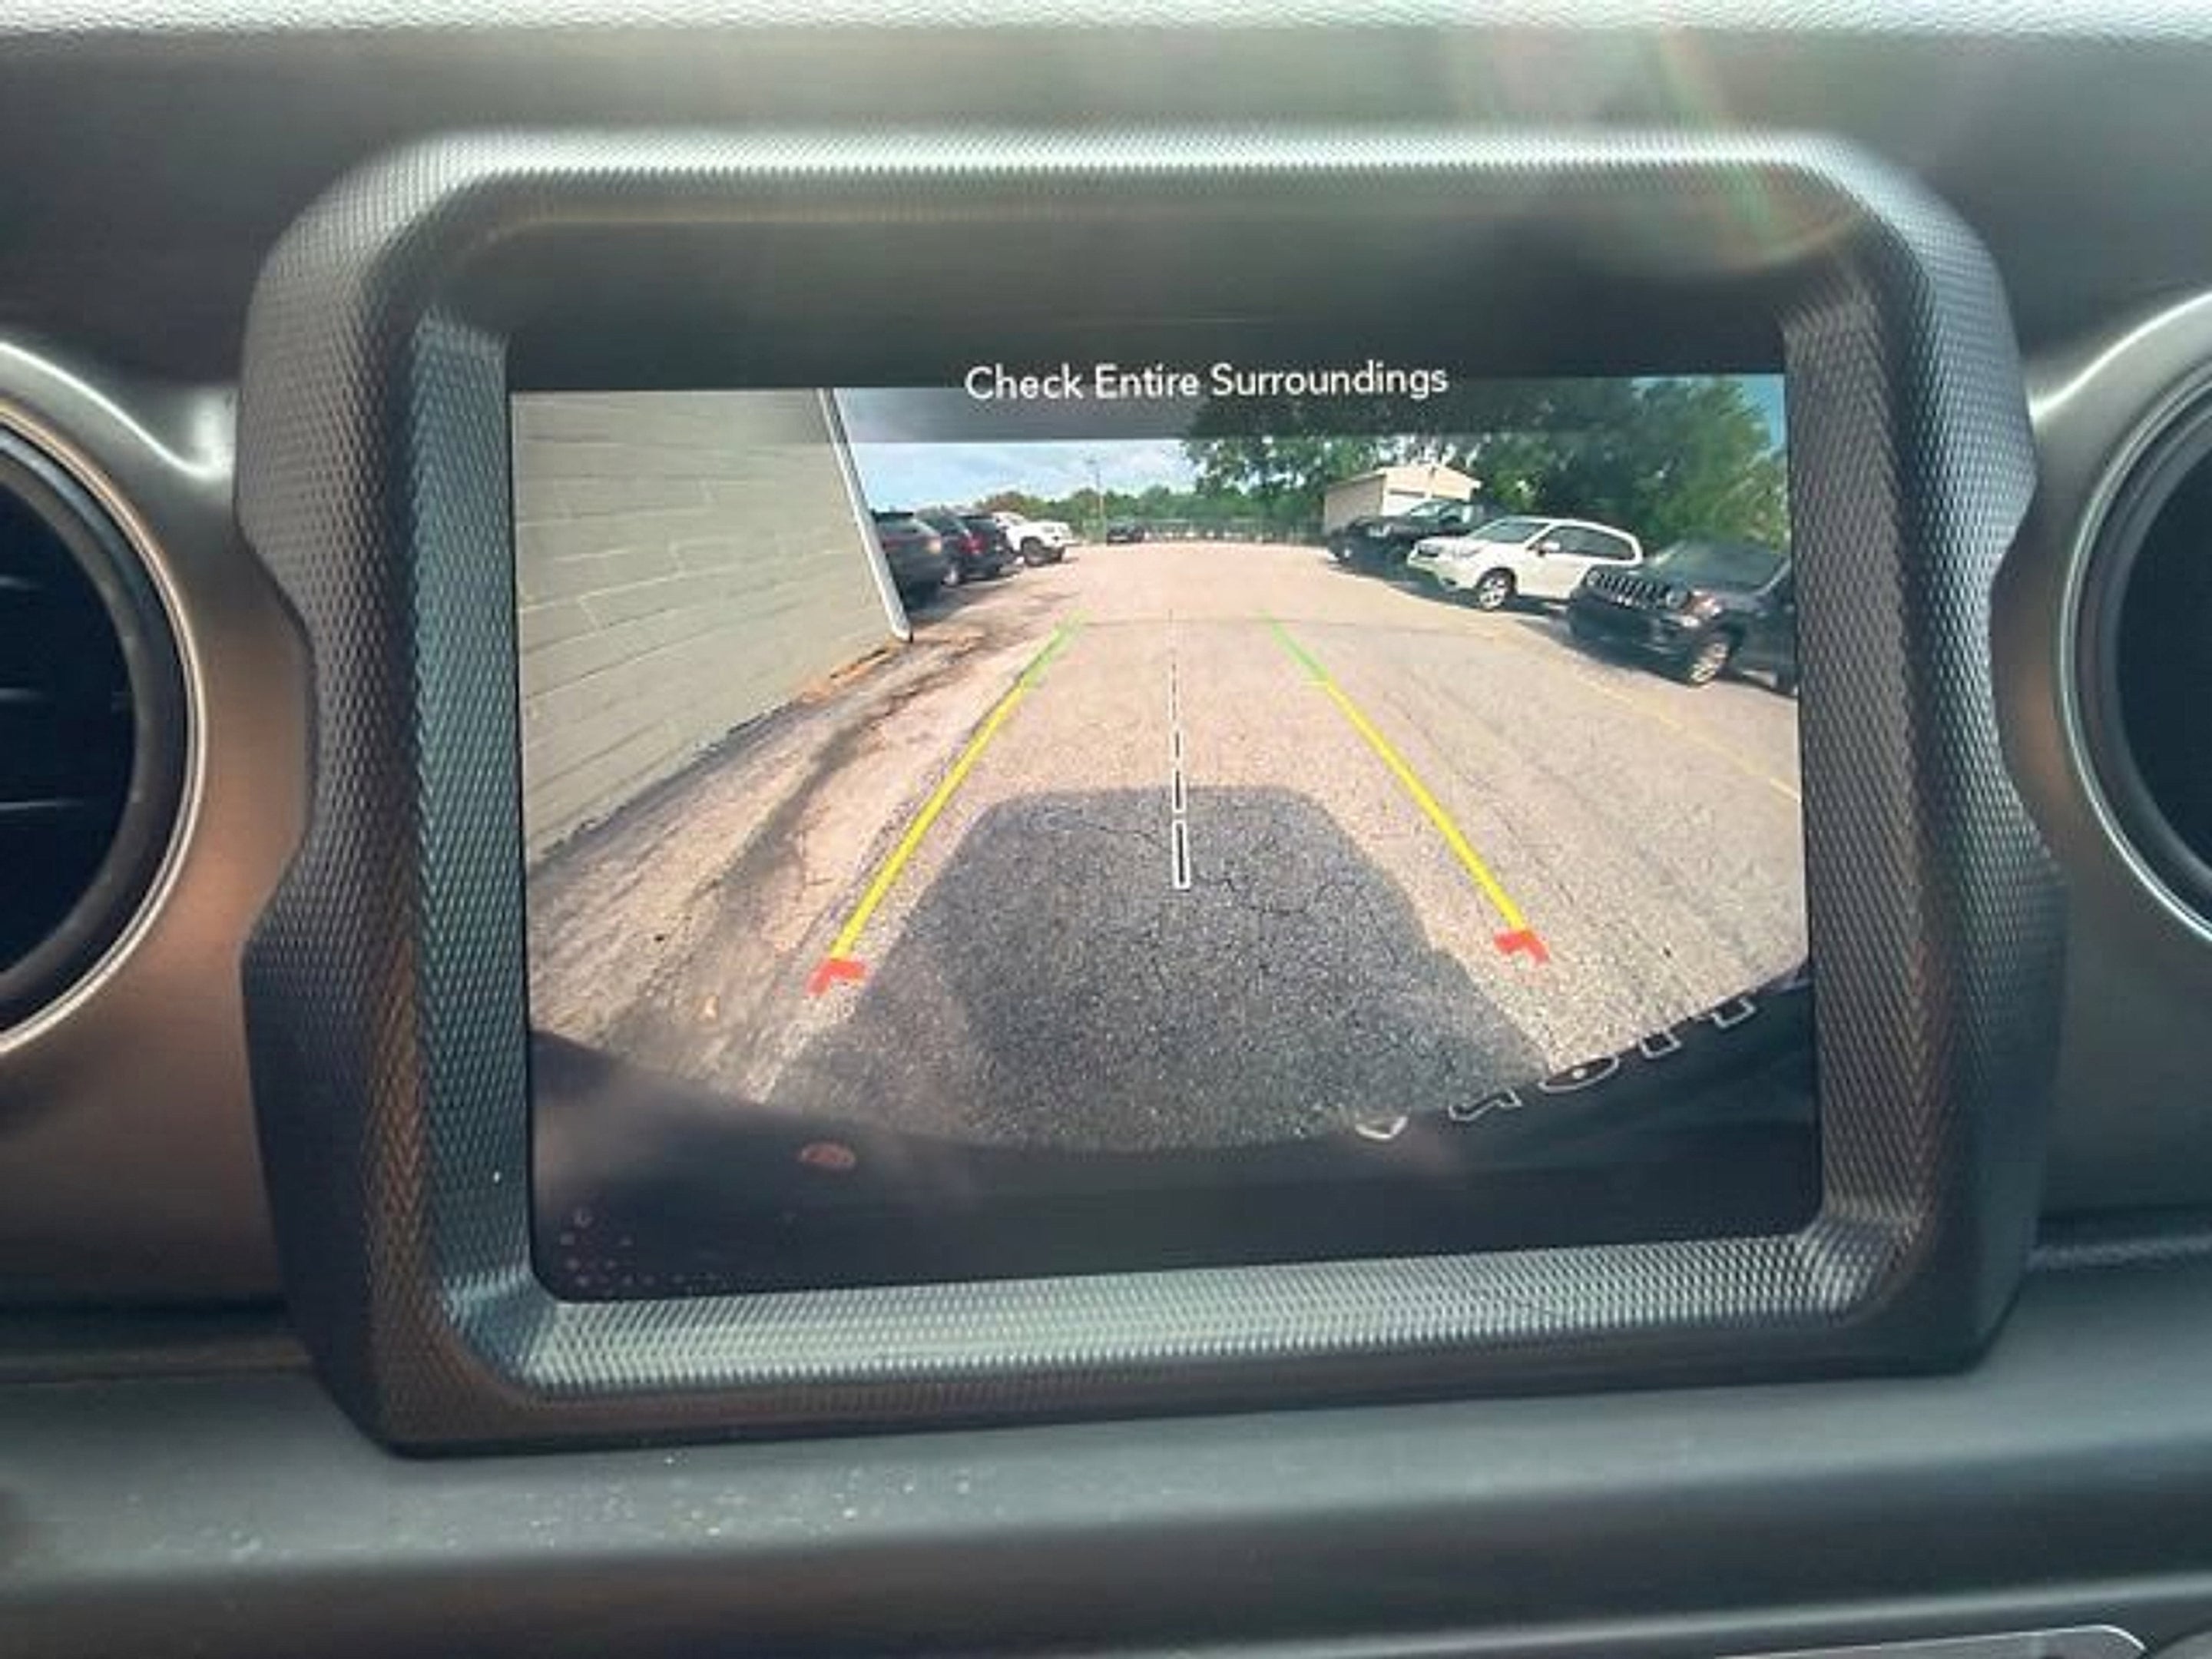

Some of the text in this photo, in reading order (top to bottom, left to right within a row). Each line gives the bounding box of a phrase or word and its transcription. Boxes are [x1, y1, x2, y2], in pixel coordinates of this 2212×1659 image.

[964, 359, 1449, 400] Check Entire Surroundings
